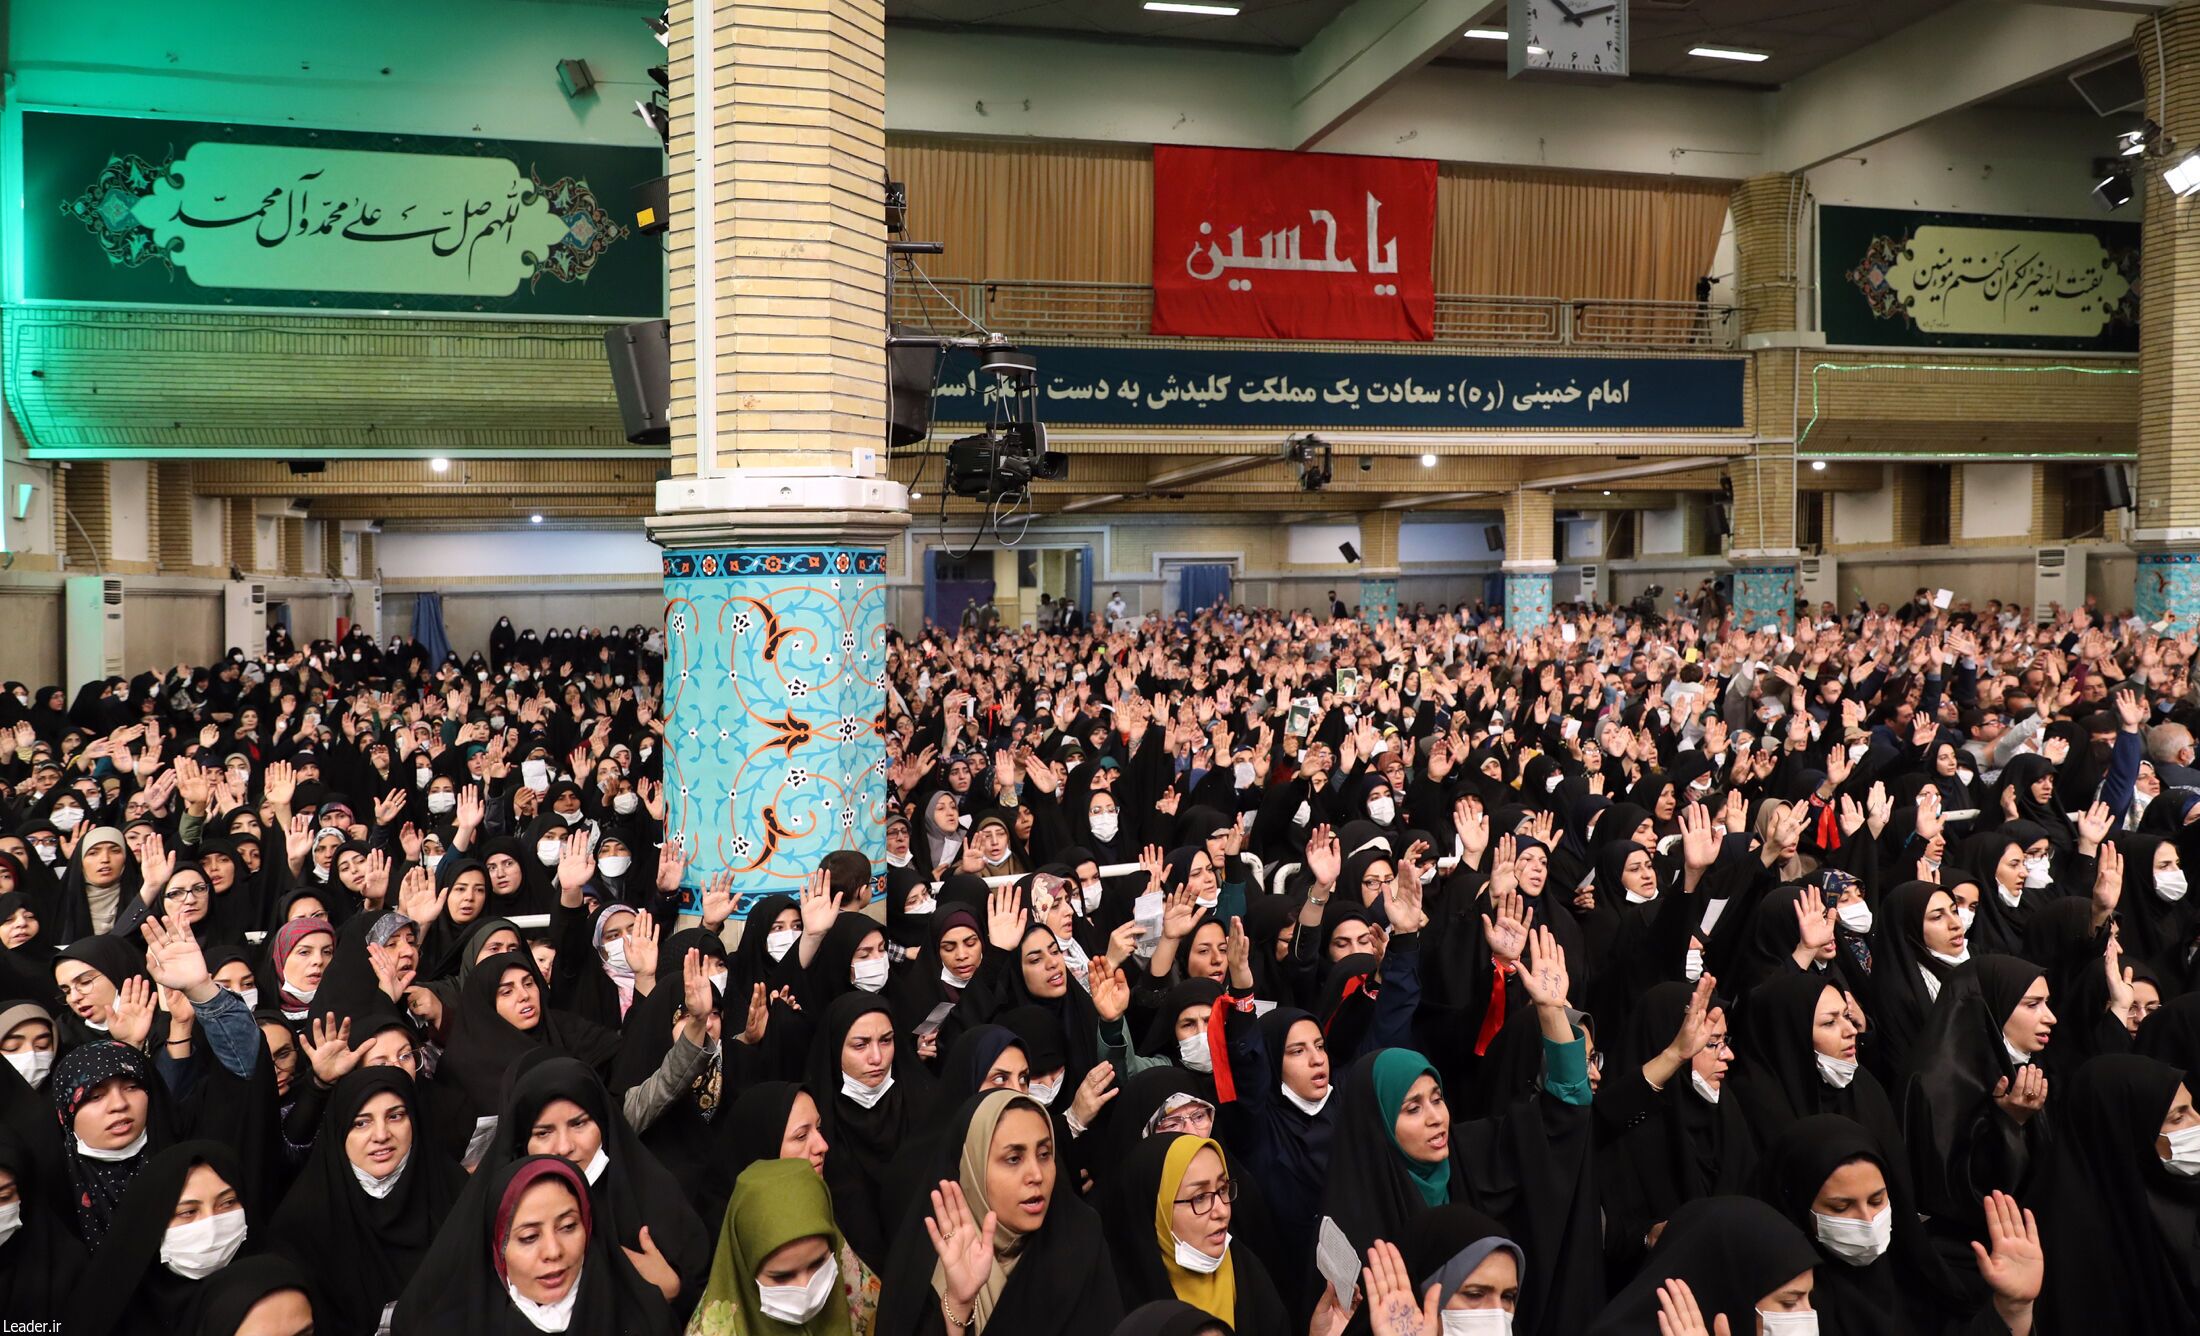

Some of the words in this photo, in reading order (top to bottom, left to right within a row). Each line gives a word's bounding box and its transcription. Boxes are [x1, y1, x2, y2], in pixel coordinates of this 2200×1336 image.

[1186, 209, 1358, 291] حسین
[1366, 190, 1398, 296] یا
[1047, 377, 1110, 400] دست
[1116, 379, 1140, 408] به
[1147, 374, 1232, 409] کلیدش
[1238, 376, 1317, 403] مملکت
[1322, 378, 1360, 409] یک
[1366, 377, 1441, 403] سعادت
[1512, 378, 1582, 411] خمینی
[1587, 379, 1630, 411] امام
